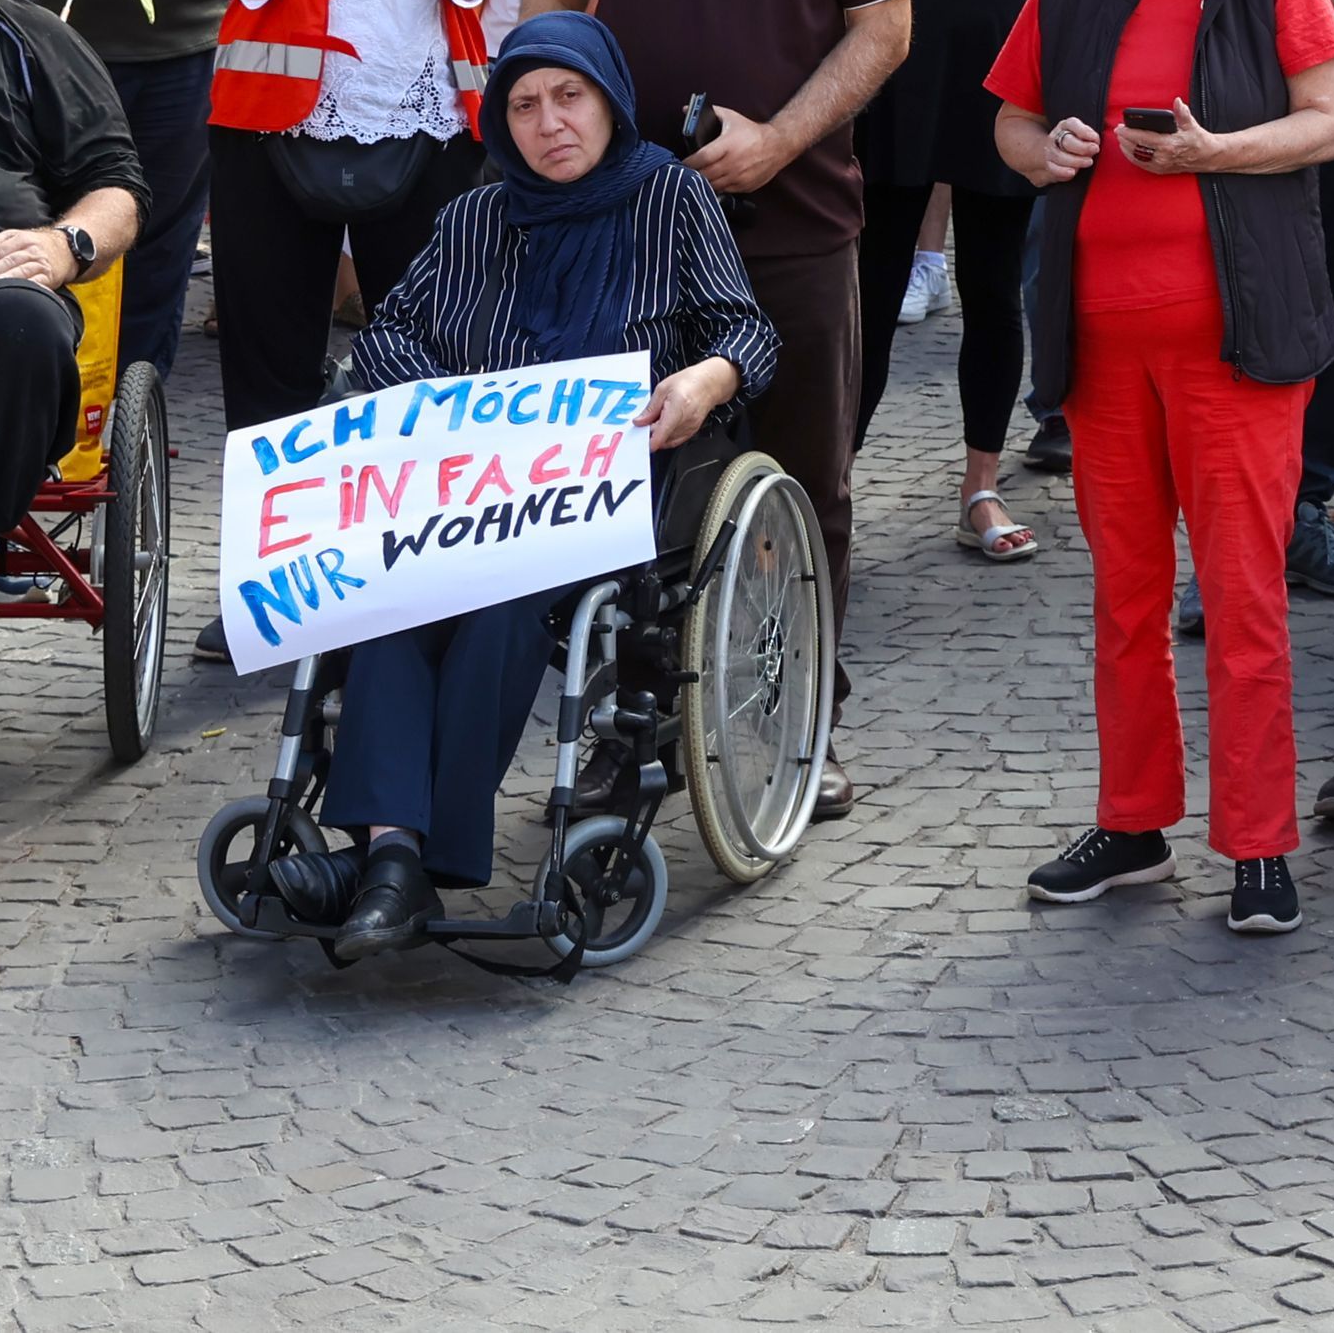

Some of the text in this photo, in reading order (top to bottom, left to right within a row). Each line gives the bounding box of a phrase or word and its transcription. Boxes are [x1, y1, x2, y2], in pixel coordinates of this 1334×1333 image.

[251, 378, 650, 476] ICH MÖCHTE
[238, 478, 647, 648] NUR WOHNEN
